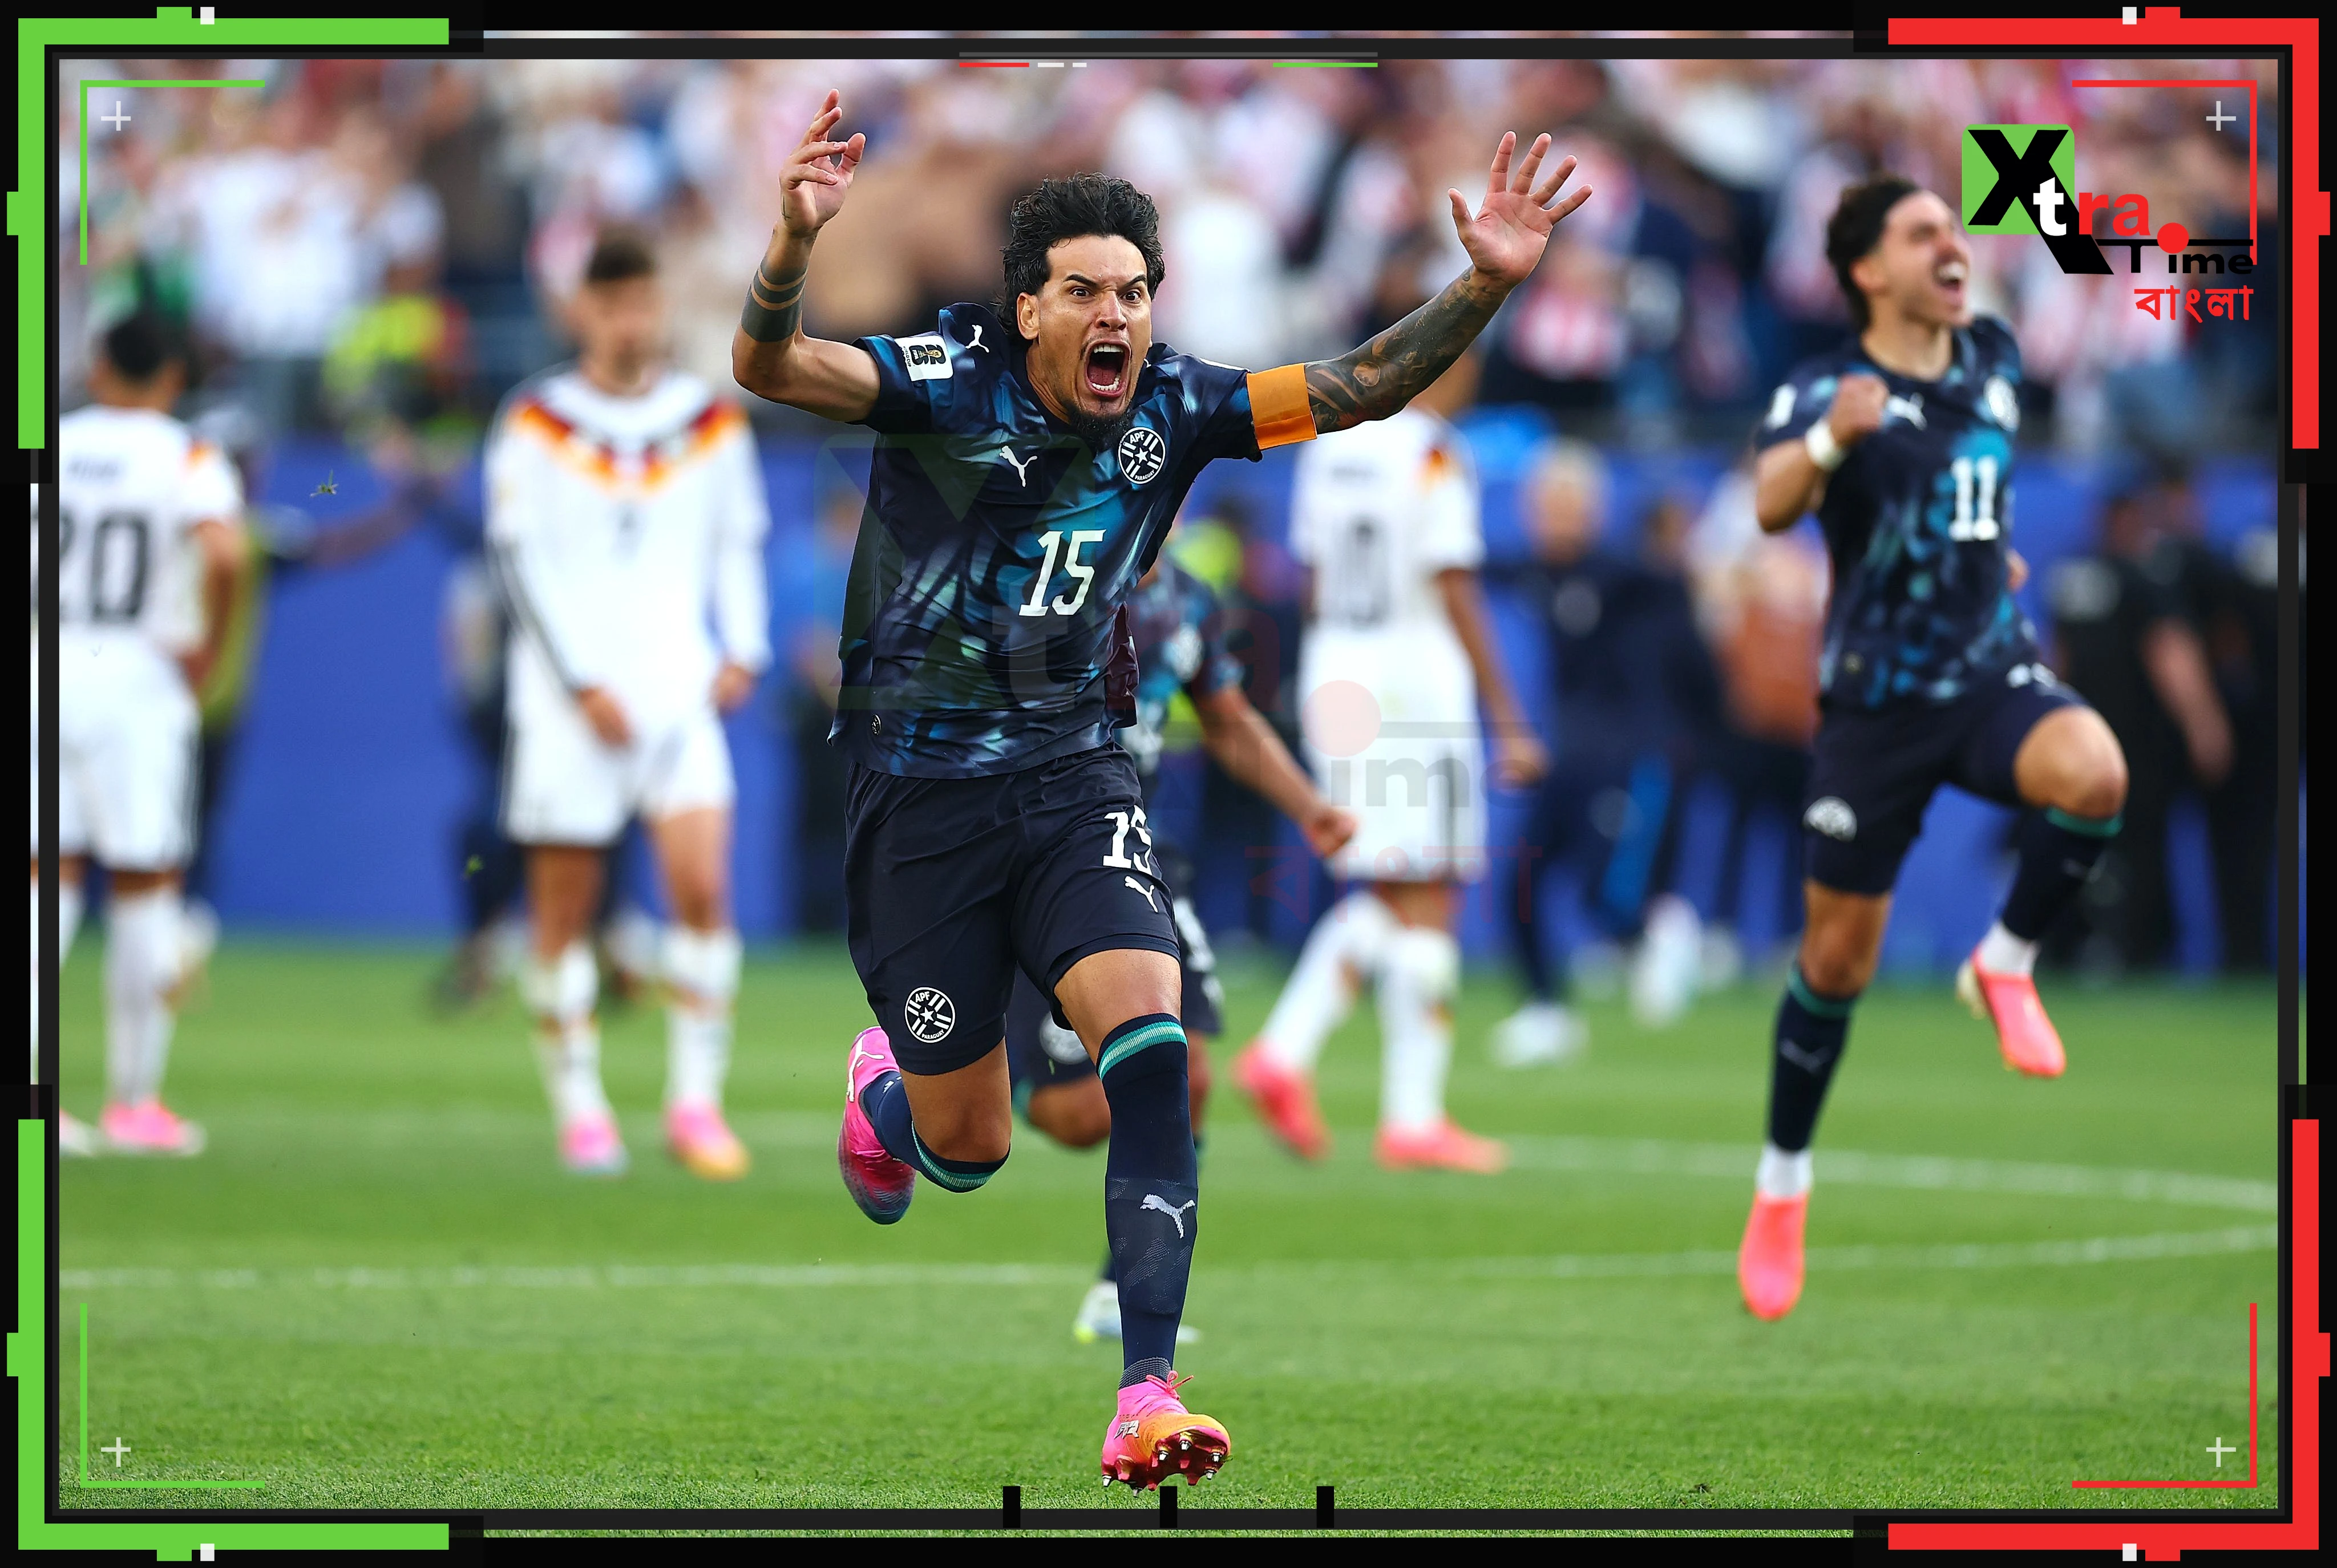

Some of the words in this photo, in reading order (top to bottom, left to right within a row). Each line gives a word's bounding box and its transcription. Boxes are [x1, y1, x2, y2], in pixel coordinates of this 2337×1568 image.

[1130, 431, 1145, 444] APF
[1134, 469, 1155, 480] PARAGUAY
[1948, 456, 1999, 541] 11
[1019, 529, 1106, 616] 15
[915, 991, 930, 1003] APF
[921, 1029, 945, 1039] PARAGUAY
